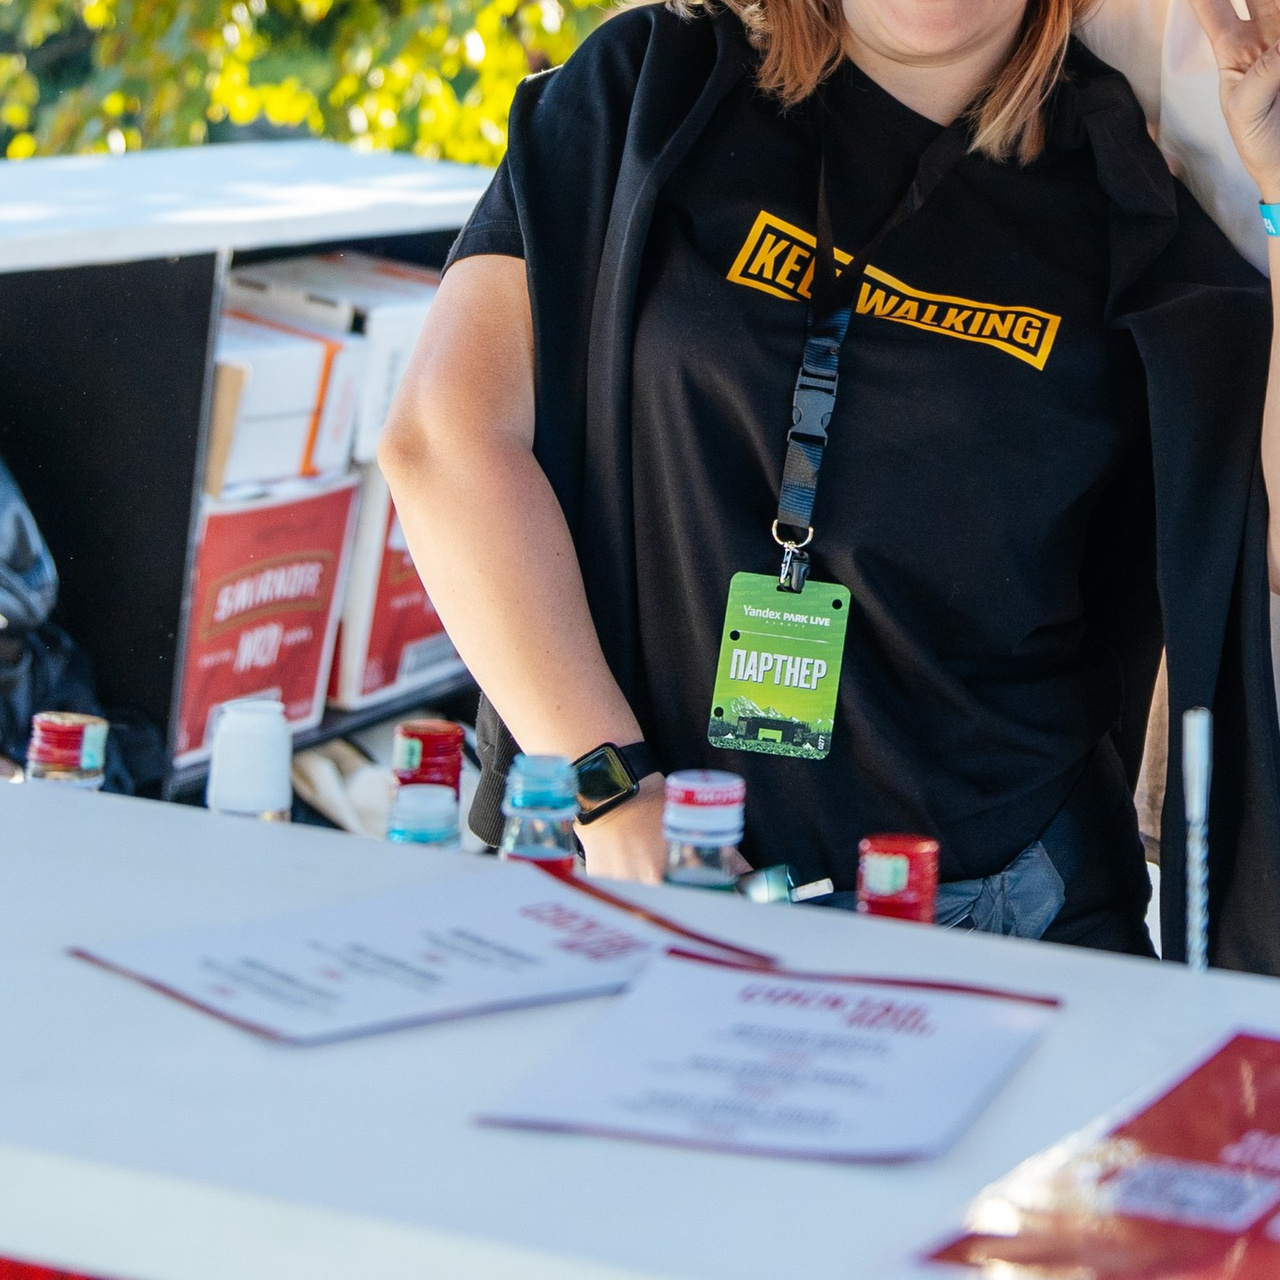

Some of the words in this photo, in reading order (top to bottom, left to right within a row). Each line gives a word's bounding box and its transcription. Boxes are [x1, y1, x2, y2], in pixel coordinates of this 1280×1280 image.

[748, 233, 842, 299] KE
[855, 282, 1043, 348] WALKING
[743, 604, 781, 620] Yandex
[783, 612, 808, 624] PARK
[810, 616, 831, 627] LIVE
[729, 648, 827, 691] ПАРТНЕР
